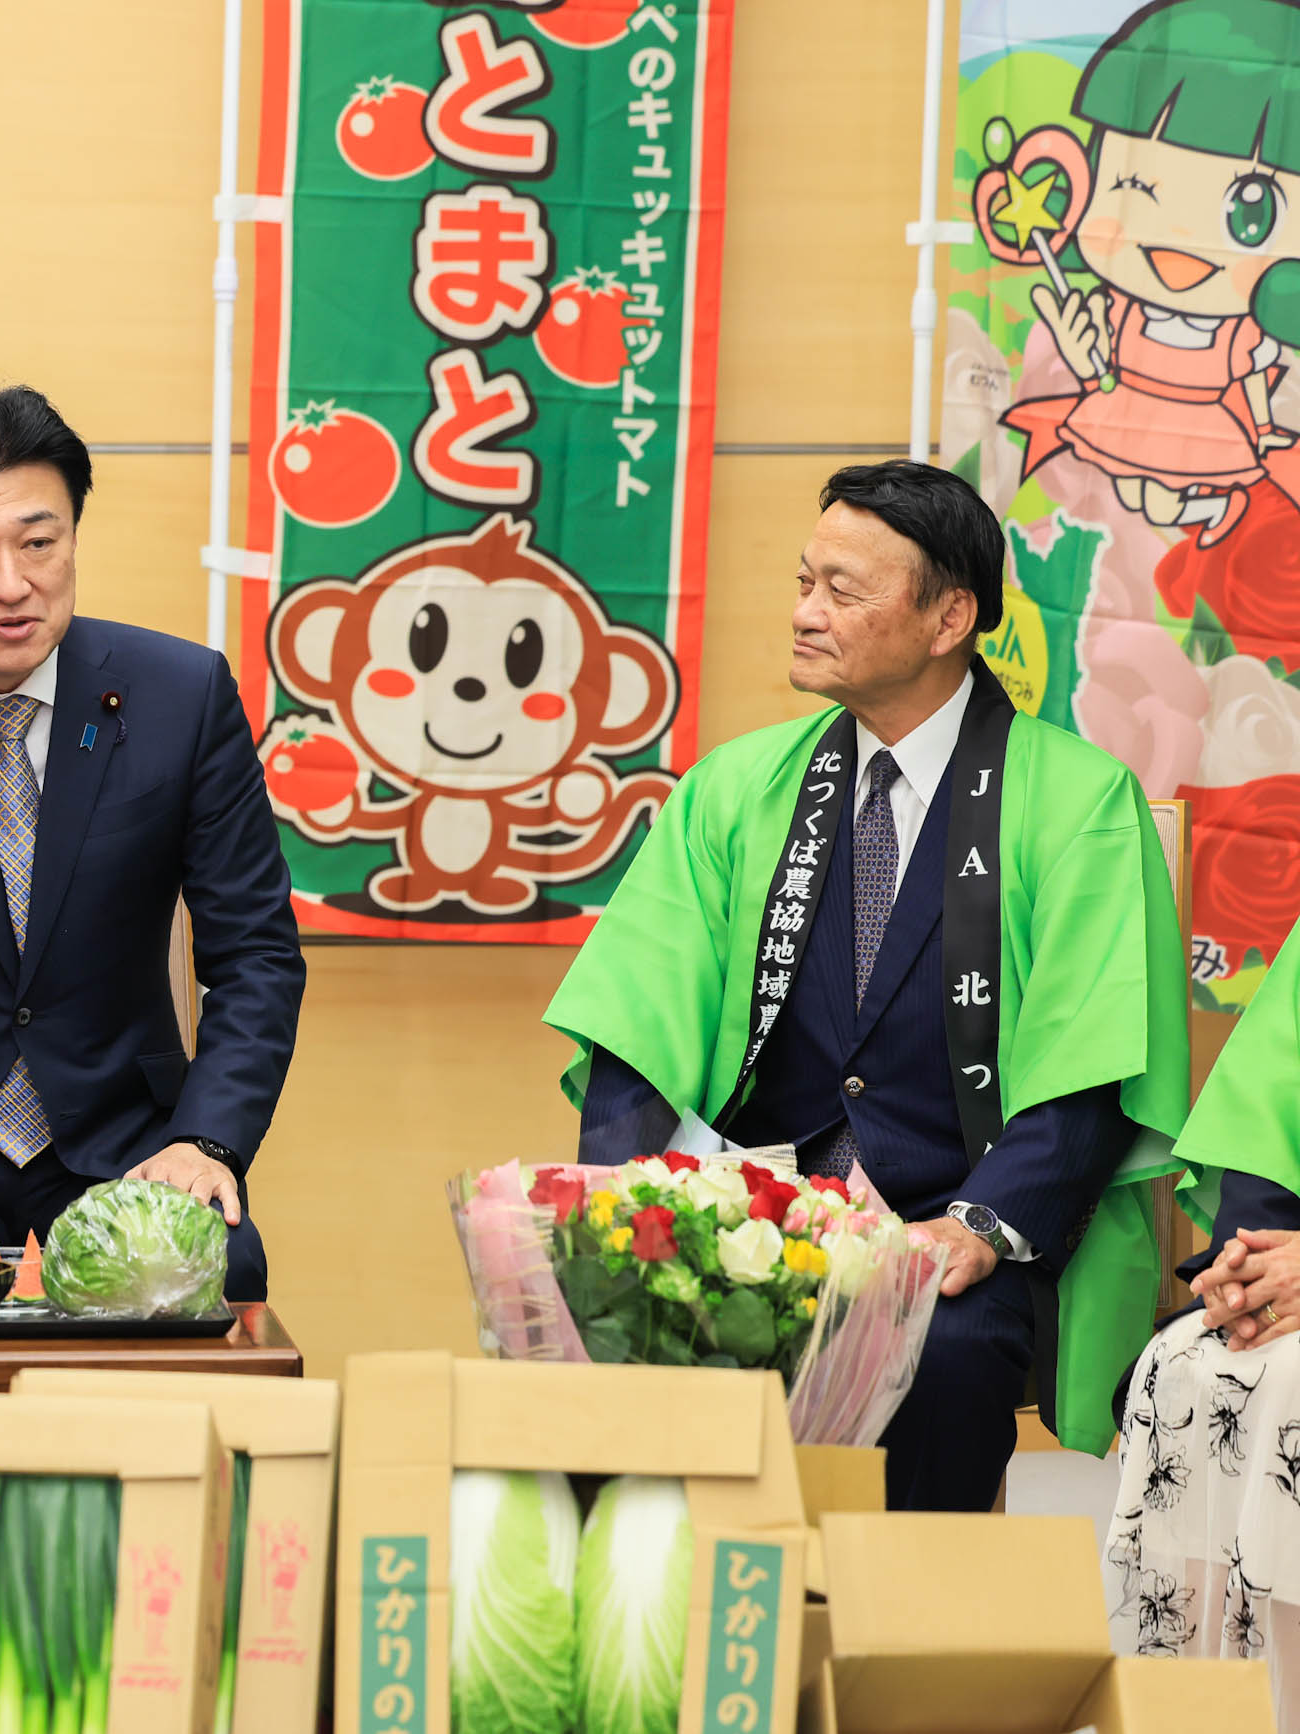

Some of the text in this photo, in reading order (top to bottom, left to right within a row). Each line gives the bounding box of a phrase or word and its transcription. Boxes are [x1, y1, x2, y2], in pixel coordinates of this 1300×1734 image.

[612, 4, 679, 508] ペのキュッキュットマト
[952, 769, 993, 1154] JA北つ
[373, 1545, 417, 1734] ひかりの
